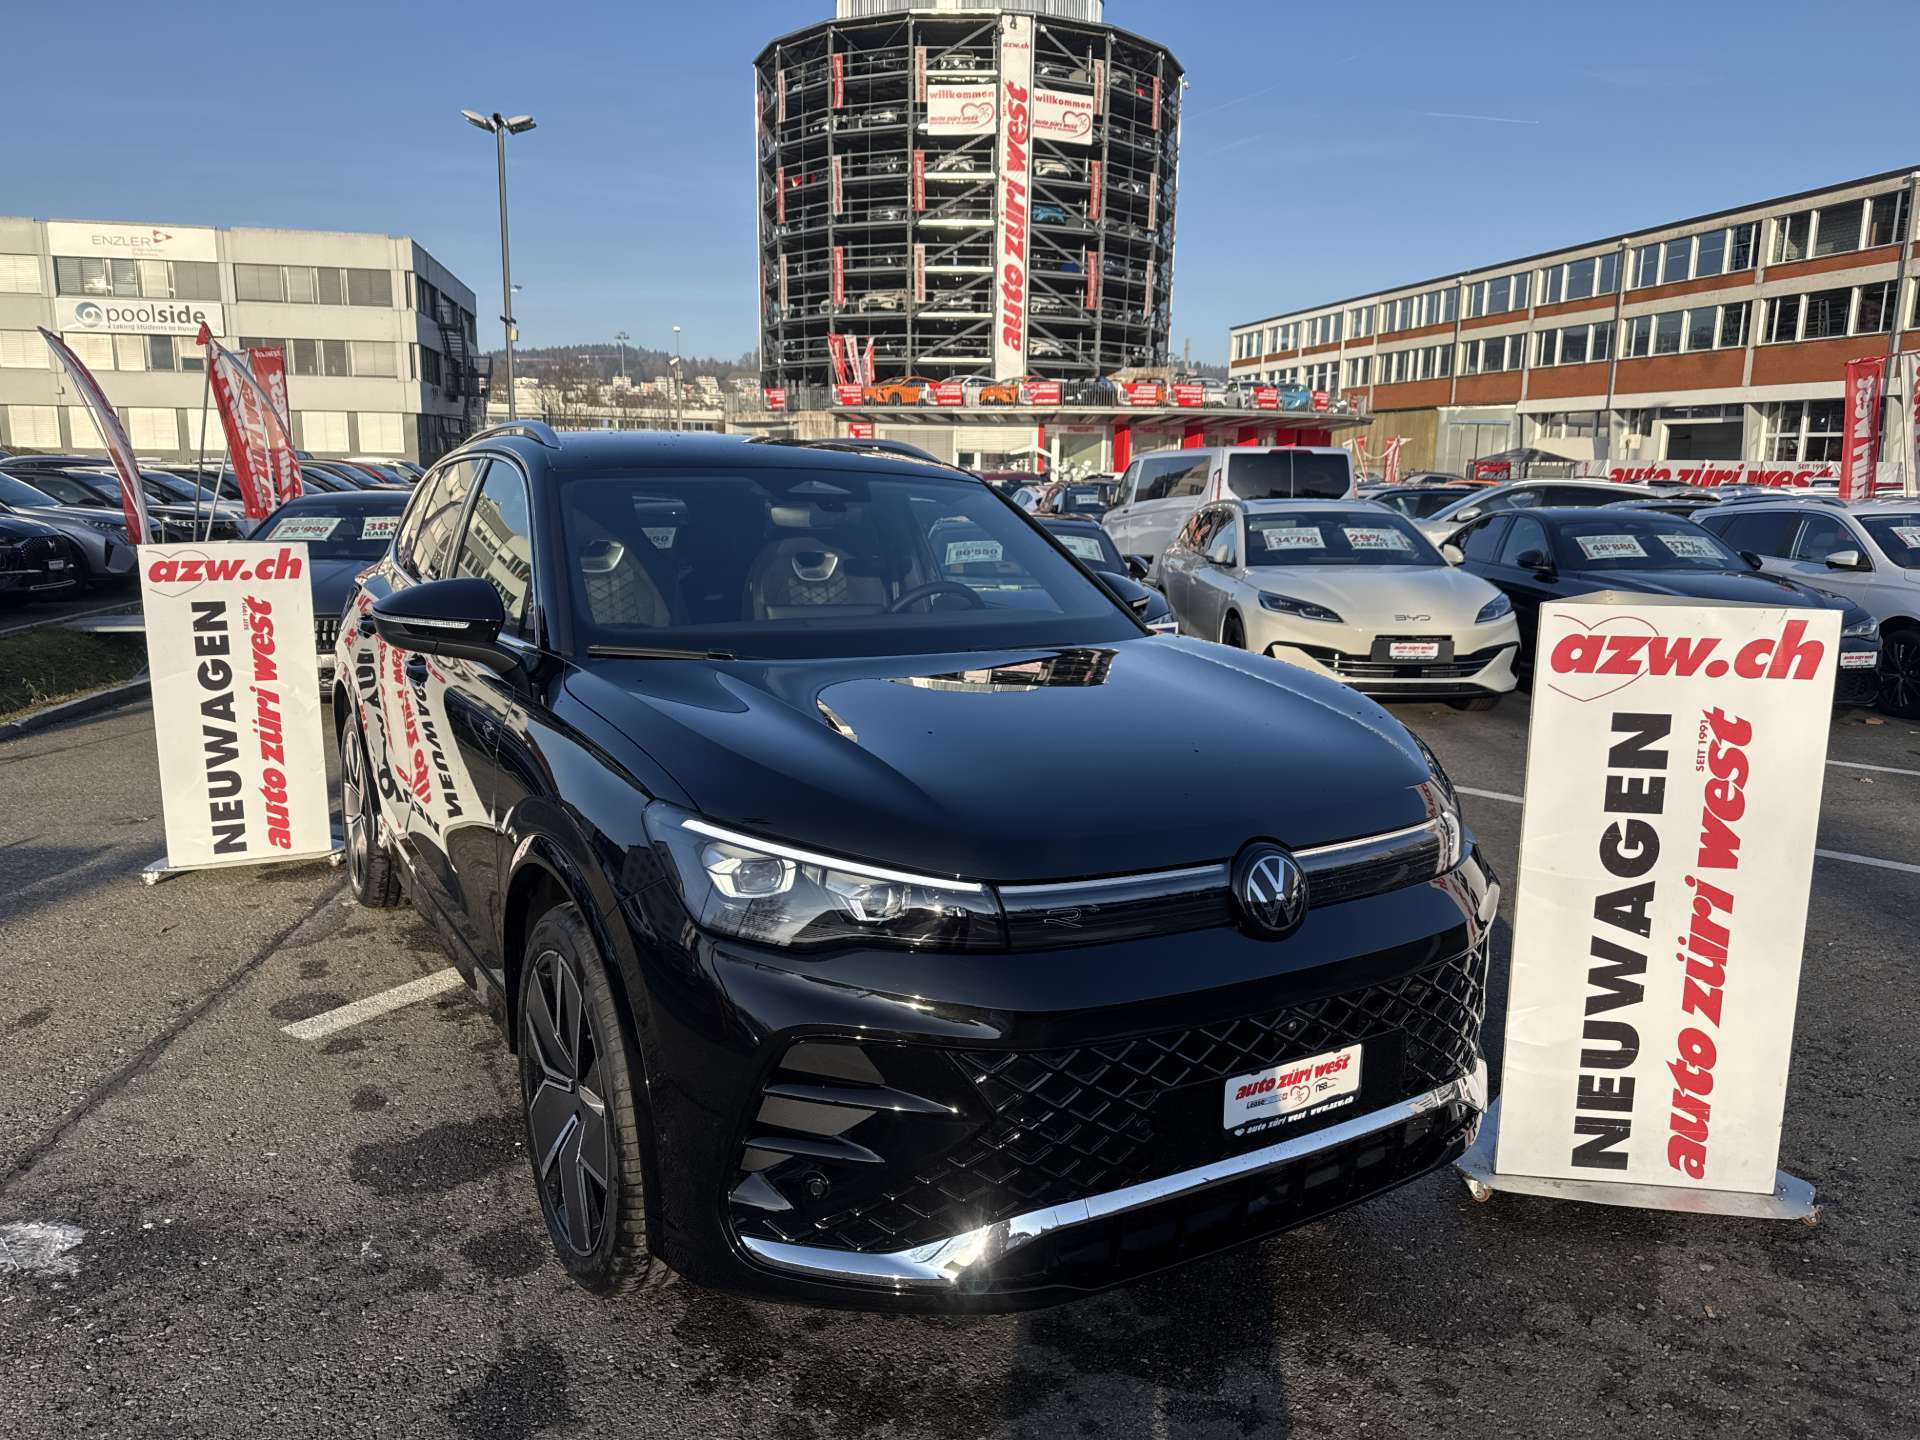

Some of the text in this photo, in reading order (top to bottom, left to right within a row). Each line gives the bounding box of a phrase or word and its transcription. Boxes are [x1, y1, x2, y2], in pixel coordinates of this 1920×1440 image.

[929, 89, 995, 100] willkommen
[1035, 94, 1092, 110] willkommen
[92, 235, 151, 247] ENZLER
[1000, 80, 1028, 352] auto züri west
[106, 303, 206, 328] poolside
[148, 547, 303, 583] azw.ch
[1550, 618, 1825, 681] azw.ch
[190, 600, 249, 855] NEUWAGEN
[241, 594, 292, 850] auto züri west
[1695, 718, 1709, 773] SEIT 1991
[1571, 712, 1673, 1171] NEUWAGEN
[1666, 706, 1753, 1181] auto züri west
[1235, 1054, 1352, 1100] auto züri west
[1246, 1095, 1354, 1134] auto züri west www.azw.ch
